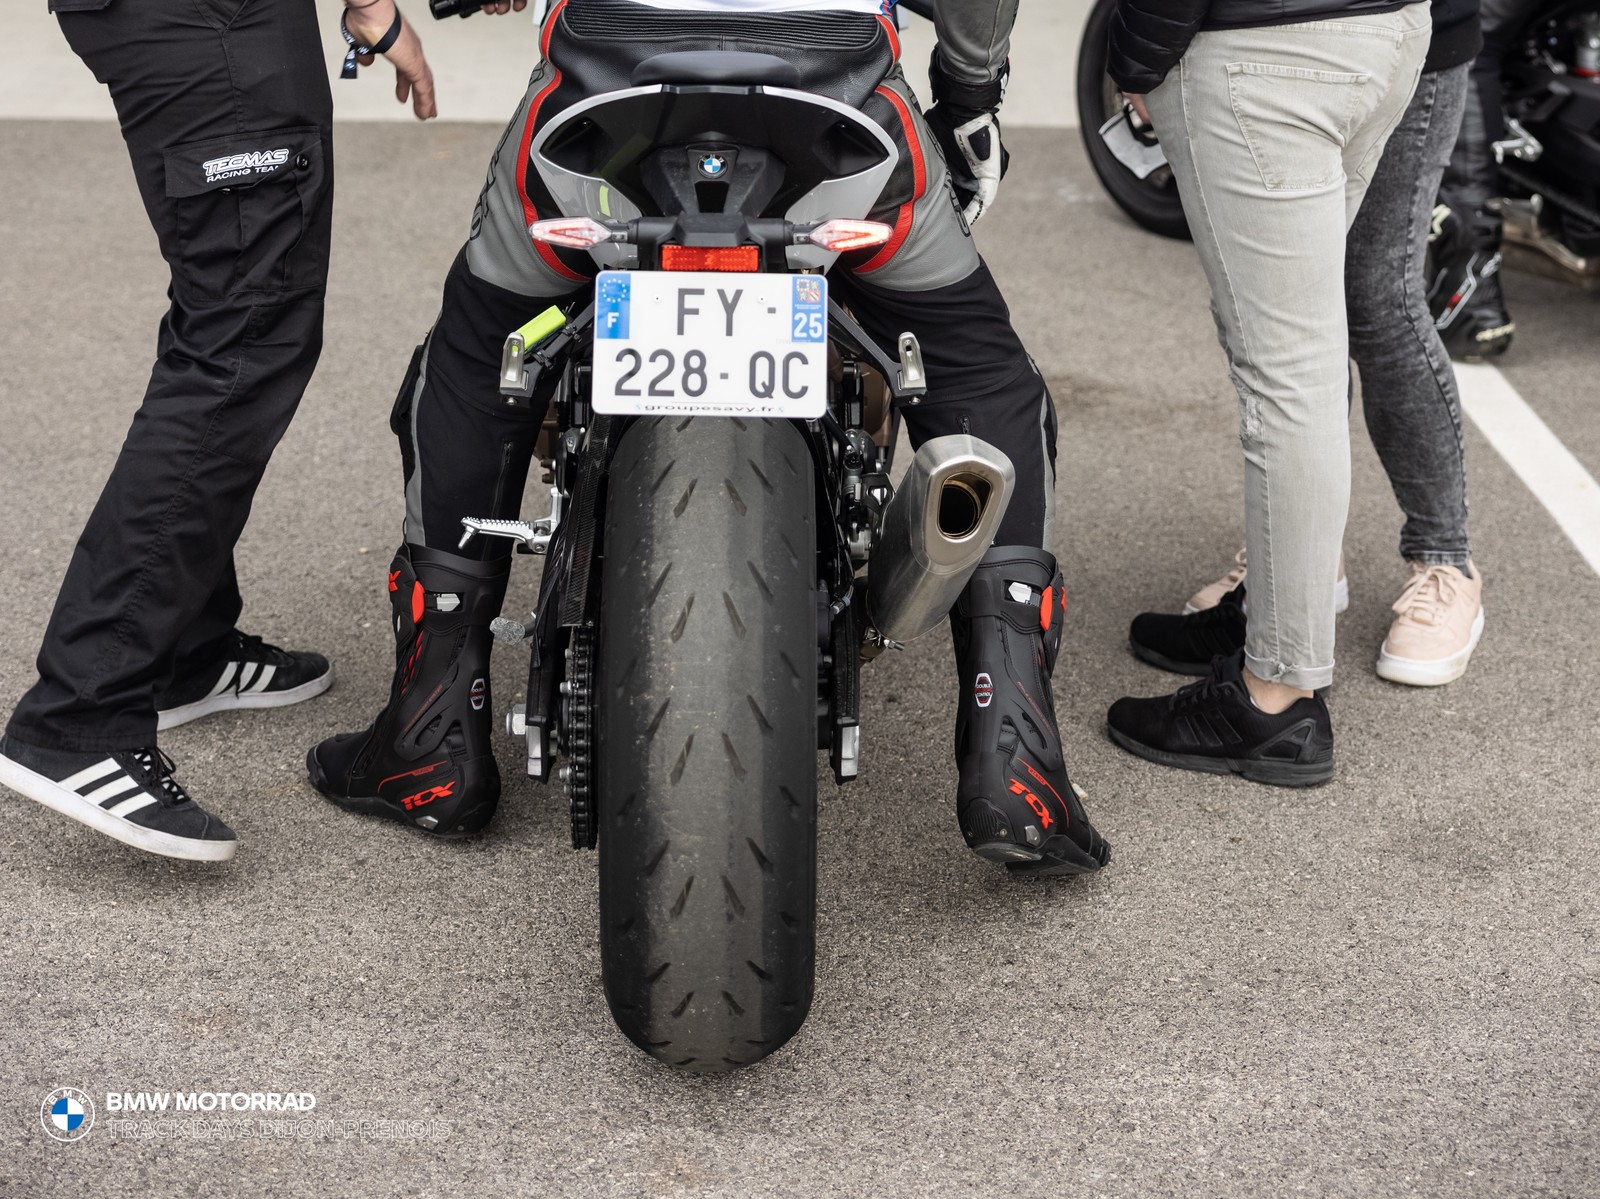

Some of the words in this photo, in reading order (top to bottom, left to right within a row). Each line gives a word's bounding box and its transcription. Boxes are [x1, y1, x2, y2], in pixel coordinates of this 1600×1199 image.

[203, 149, 289, 176] TECMAS
[206, 168, 251, 183] RACING
[607, 312, 620, 328] F
[793, 312, 823, 339] 25
[401, 780, 456, 811] TCX
[1009, 778, 1054, 829] TCX
